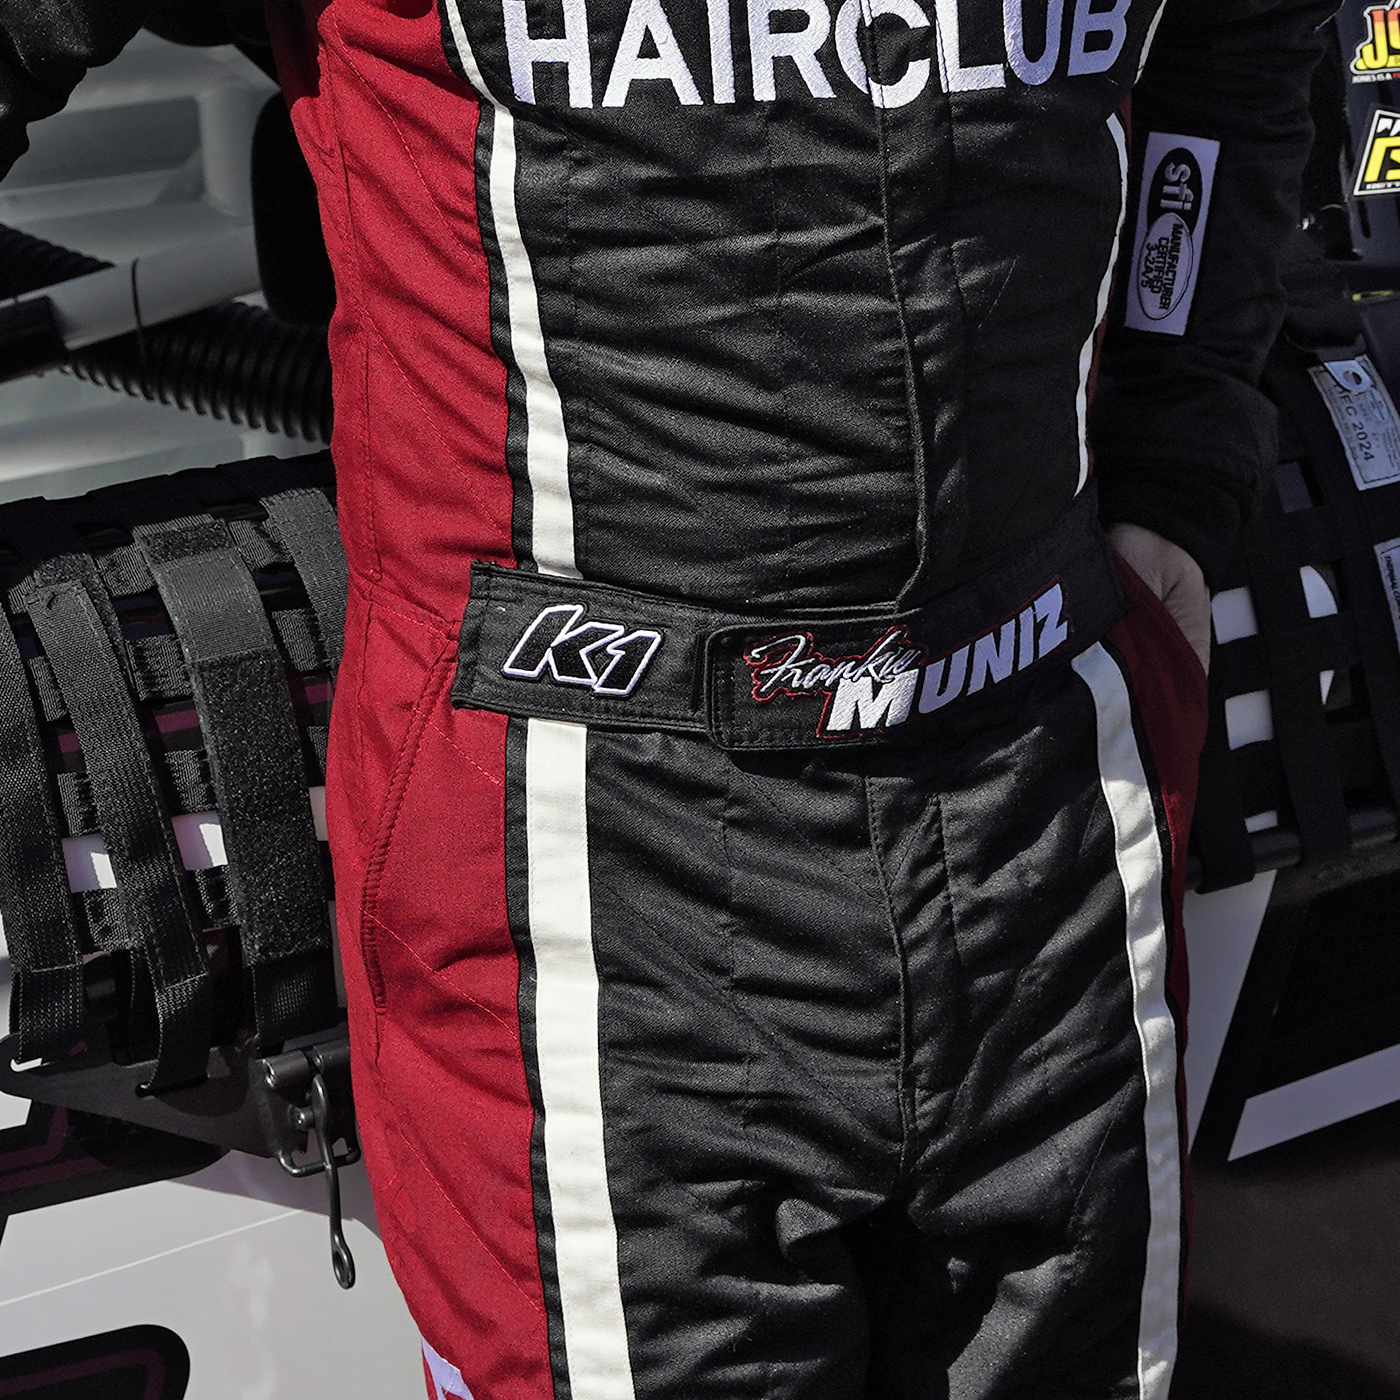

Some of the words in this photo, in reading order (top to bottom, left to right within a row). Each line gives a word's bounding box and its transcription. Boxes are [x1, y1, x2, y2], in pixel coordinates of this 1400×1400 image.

[1150, 237, 1170, 294] CERTIFIED
[1159, 223, 1184, 310] MANUFACTURER
[1352, 422, 1375, 461] 2024
[503, 603, 663, 697] K1
[751, 630, 921, 692] Frankie
[826, 582, 1069, 731] MUNIZ
